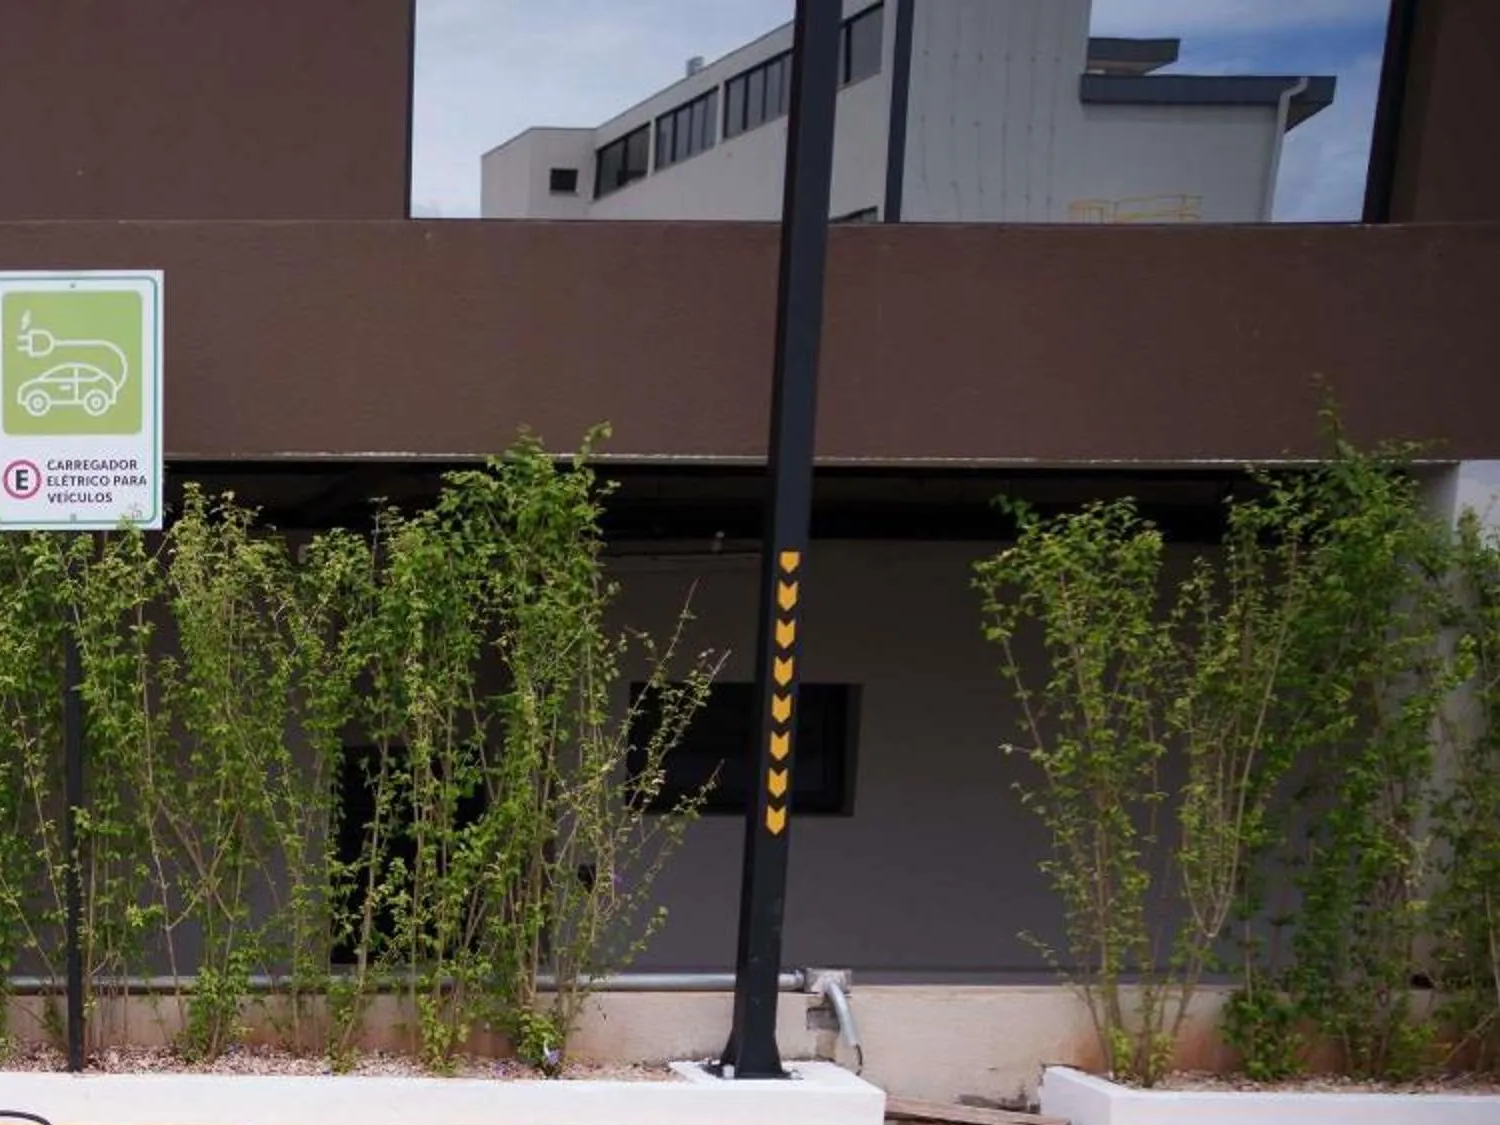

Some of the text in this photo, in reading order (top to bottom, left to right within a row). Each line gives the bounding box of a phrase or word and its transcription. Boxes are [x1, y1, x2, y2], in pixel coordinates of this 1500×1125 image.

[47, 459, 138, 471] CARREGADOR
[15, 469, 29, 491] E
[47, 474, 147, 487] ELÉTRICO PARA
[47, 490, 113, 503] VEÍCULOS
